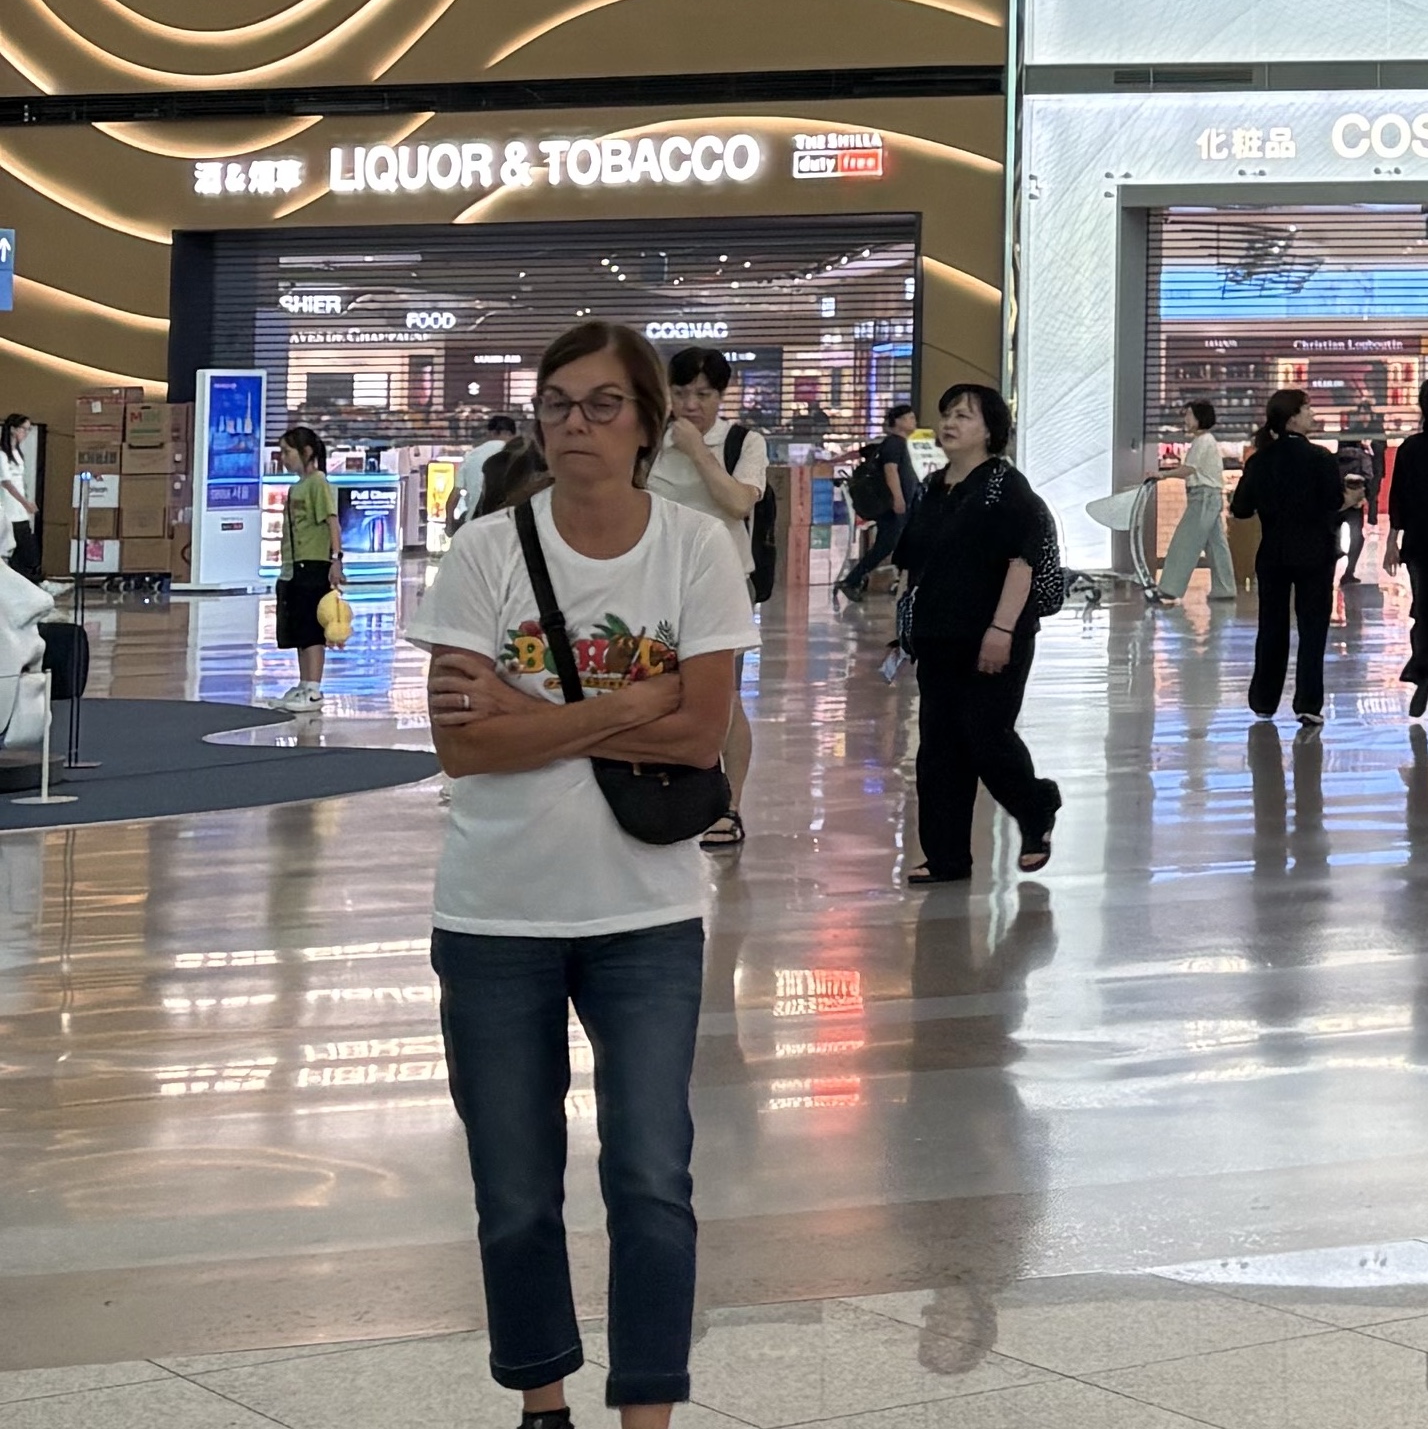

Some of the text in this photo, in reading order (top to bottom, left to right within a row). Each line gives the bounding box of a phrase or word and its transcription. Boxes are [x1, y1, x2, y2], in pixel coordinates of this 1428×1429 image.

[792, 132, 882, 149] THE SHILLA
[1195, 127, 1297, 160] 化粧品
[329, 133, 762, 193] LIQUOR & TOBACCO
[405, 311, 457, 329] FOOD
[645, 322, 729, 339] COGNAC
